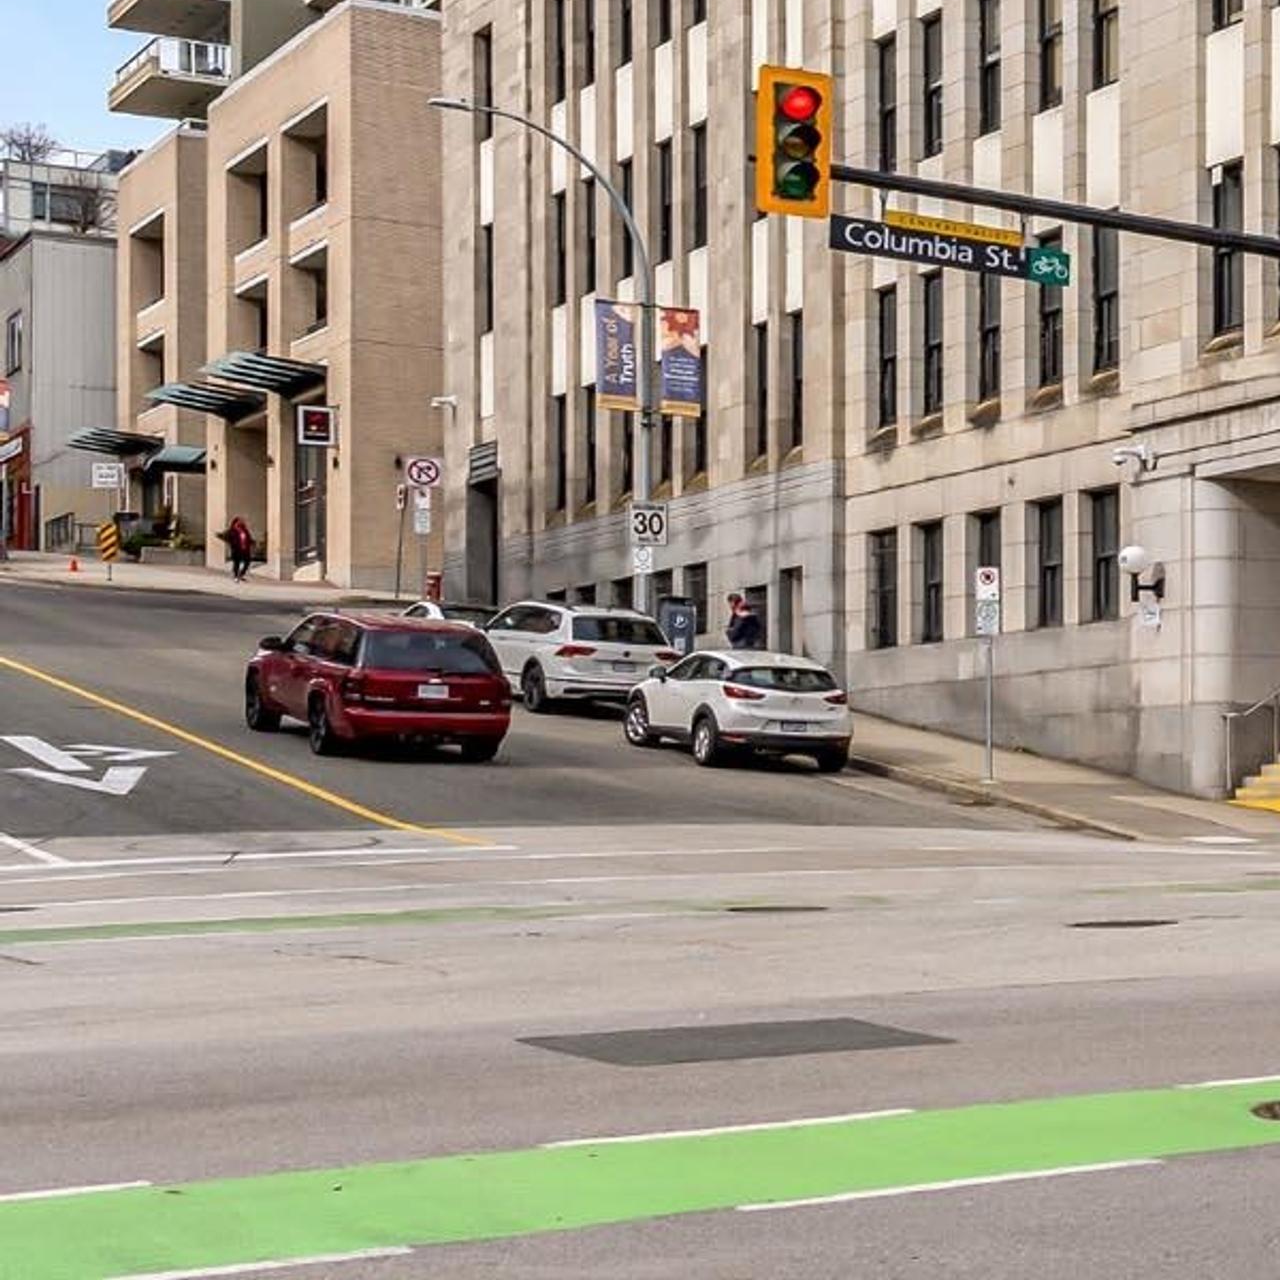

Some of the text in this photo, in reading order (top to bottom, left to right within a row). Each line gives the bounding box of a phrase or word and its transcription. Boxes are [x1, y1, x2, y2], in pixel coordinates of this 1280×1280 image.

[844, 222, 1018, 270] Columbia St.
[619, 343, 633, 384] Truth
[633, 512, 663, 534] 30
